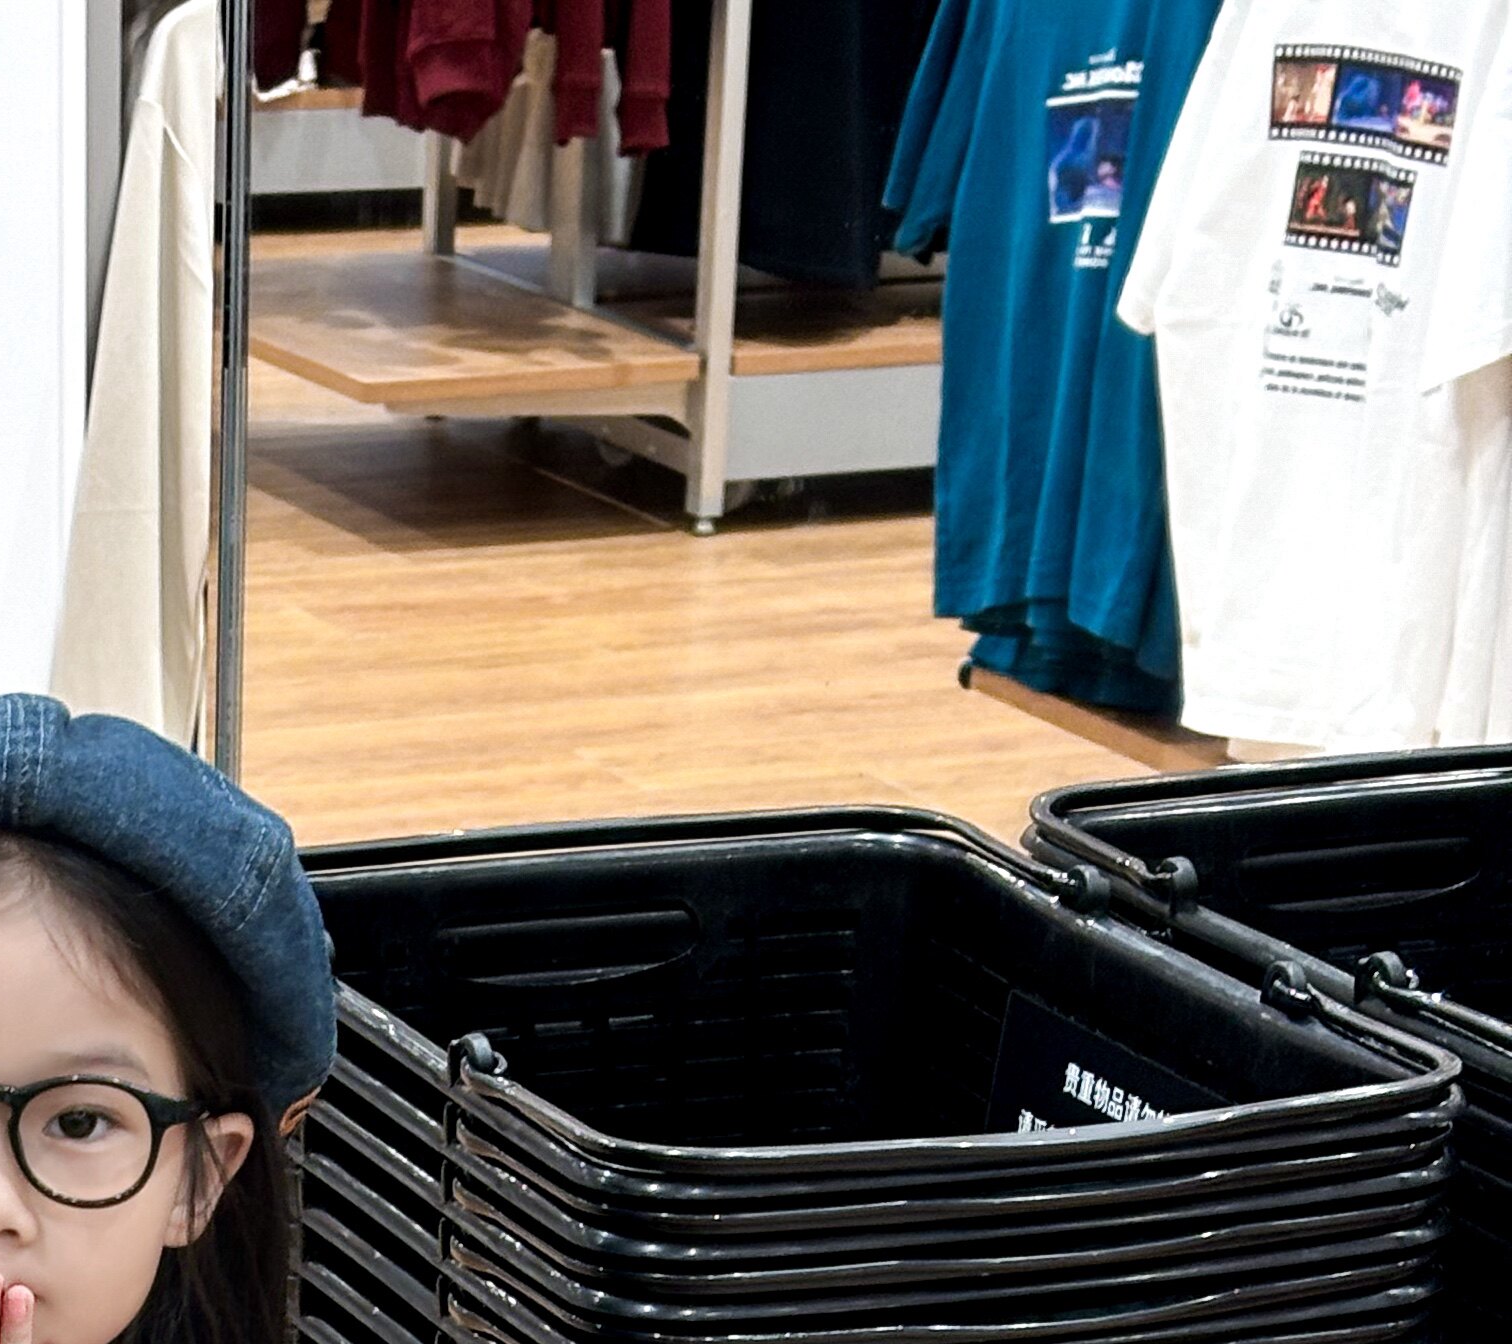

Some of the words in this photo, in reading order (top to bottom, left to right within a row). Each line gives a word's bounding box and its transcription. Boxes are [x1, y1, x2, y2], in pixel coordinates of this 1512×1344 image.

[1062, 1062, 1172, 1122] 贵重物品请勿
